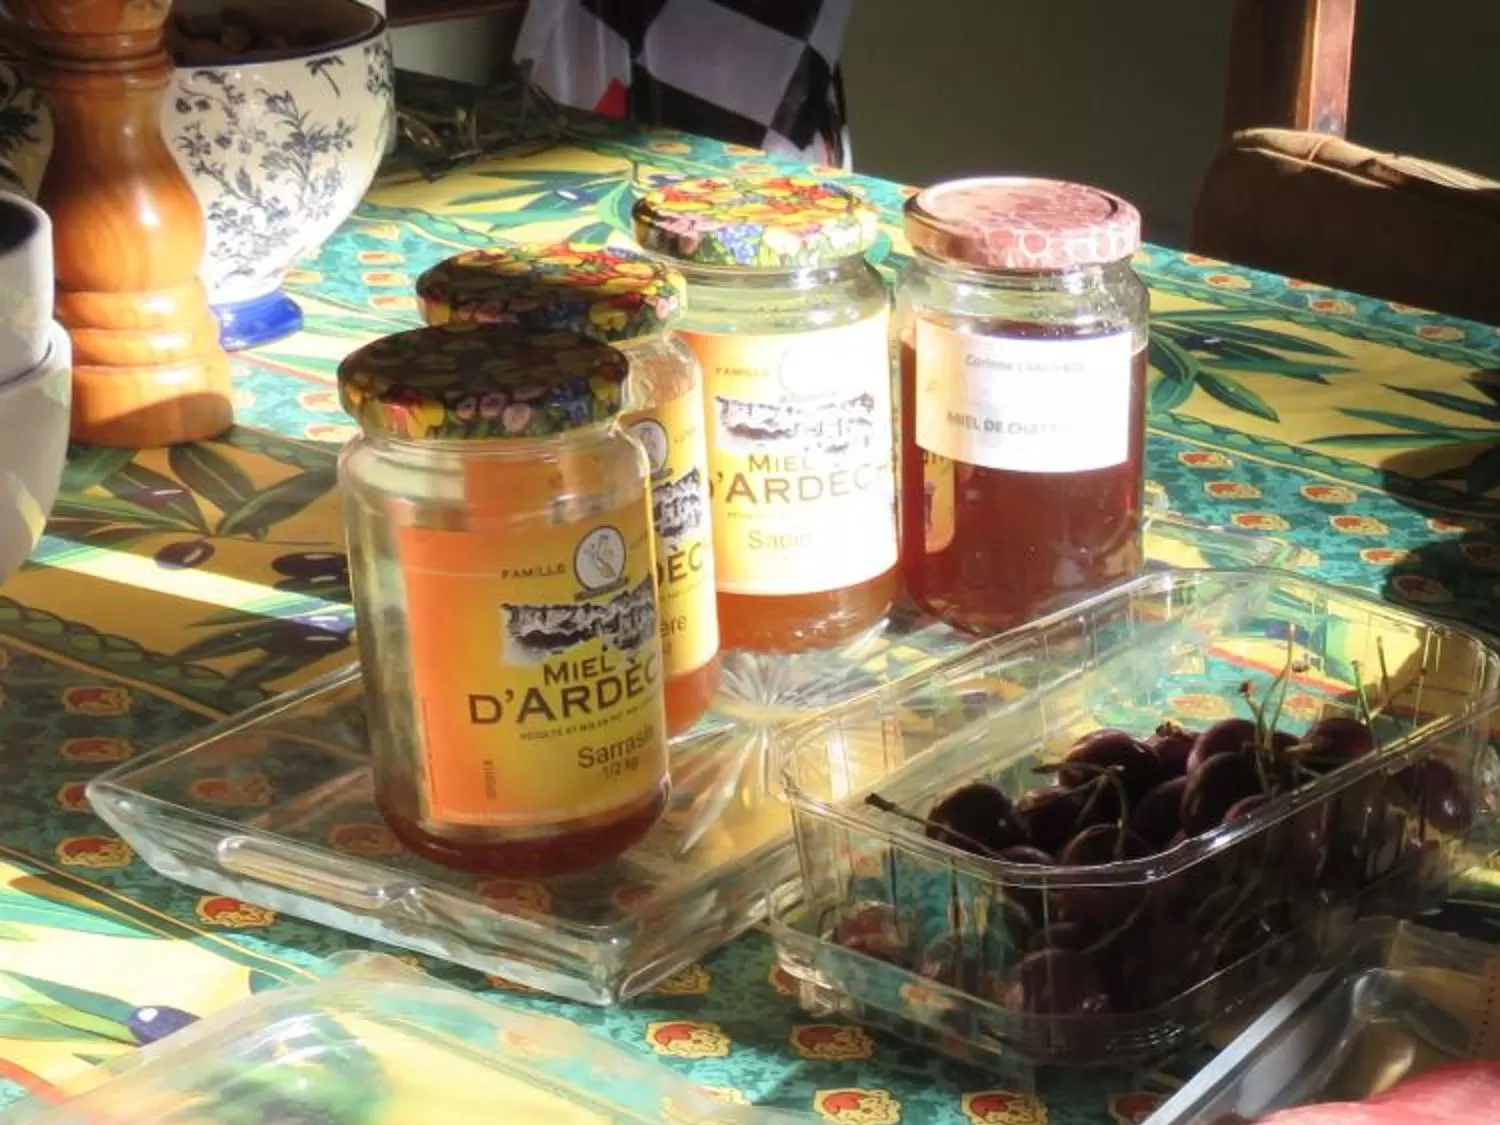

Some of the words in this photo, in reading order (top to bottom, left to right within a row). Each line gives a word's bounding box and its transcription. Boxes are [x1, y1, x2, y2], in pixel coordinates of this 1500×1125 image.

[983, 418, 1003, 434] DE
[748, 453, 815, 474] MIEL
[709, 462, 887, 505] 'ARDÈC
[500, 562, 566, 580] FAMILLE
[543, 655, 617, 687] MIEL
[467, 651, 658, 725] D'ARDÈC
